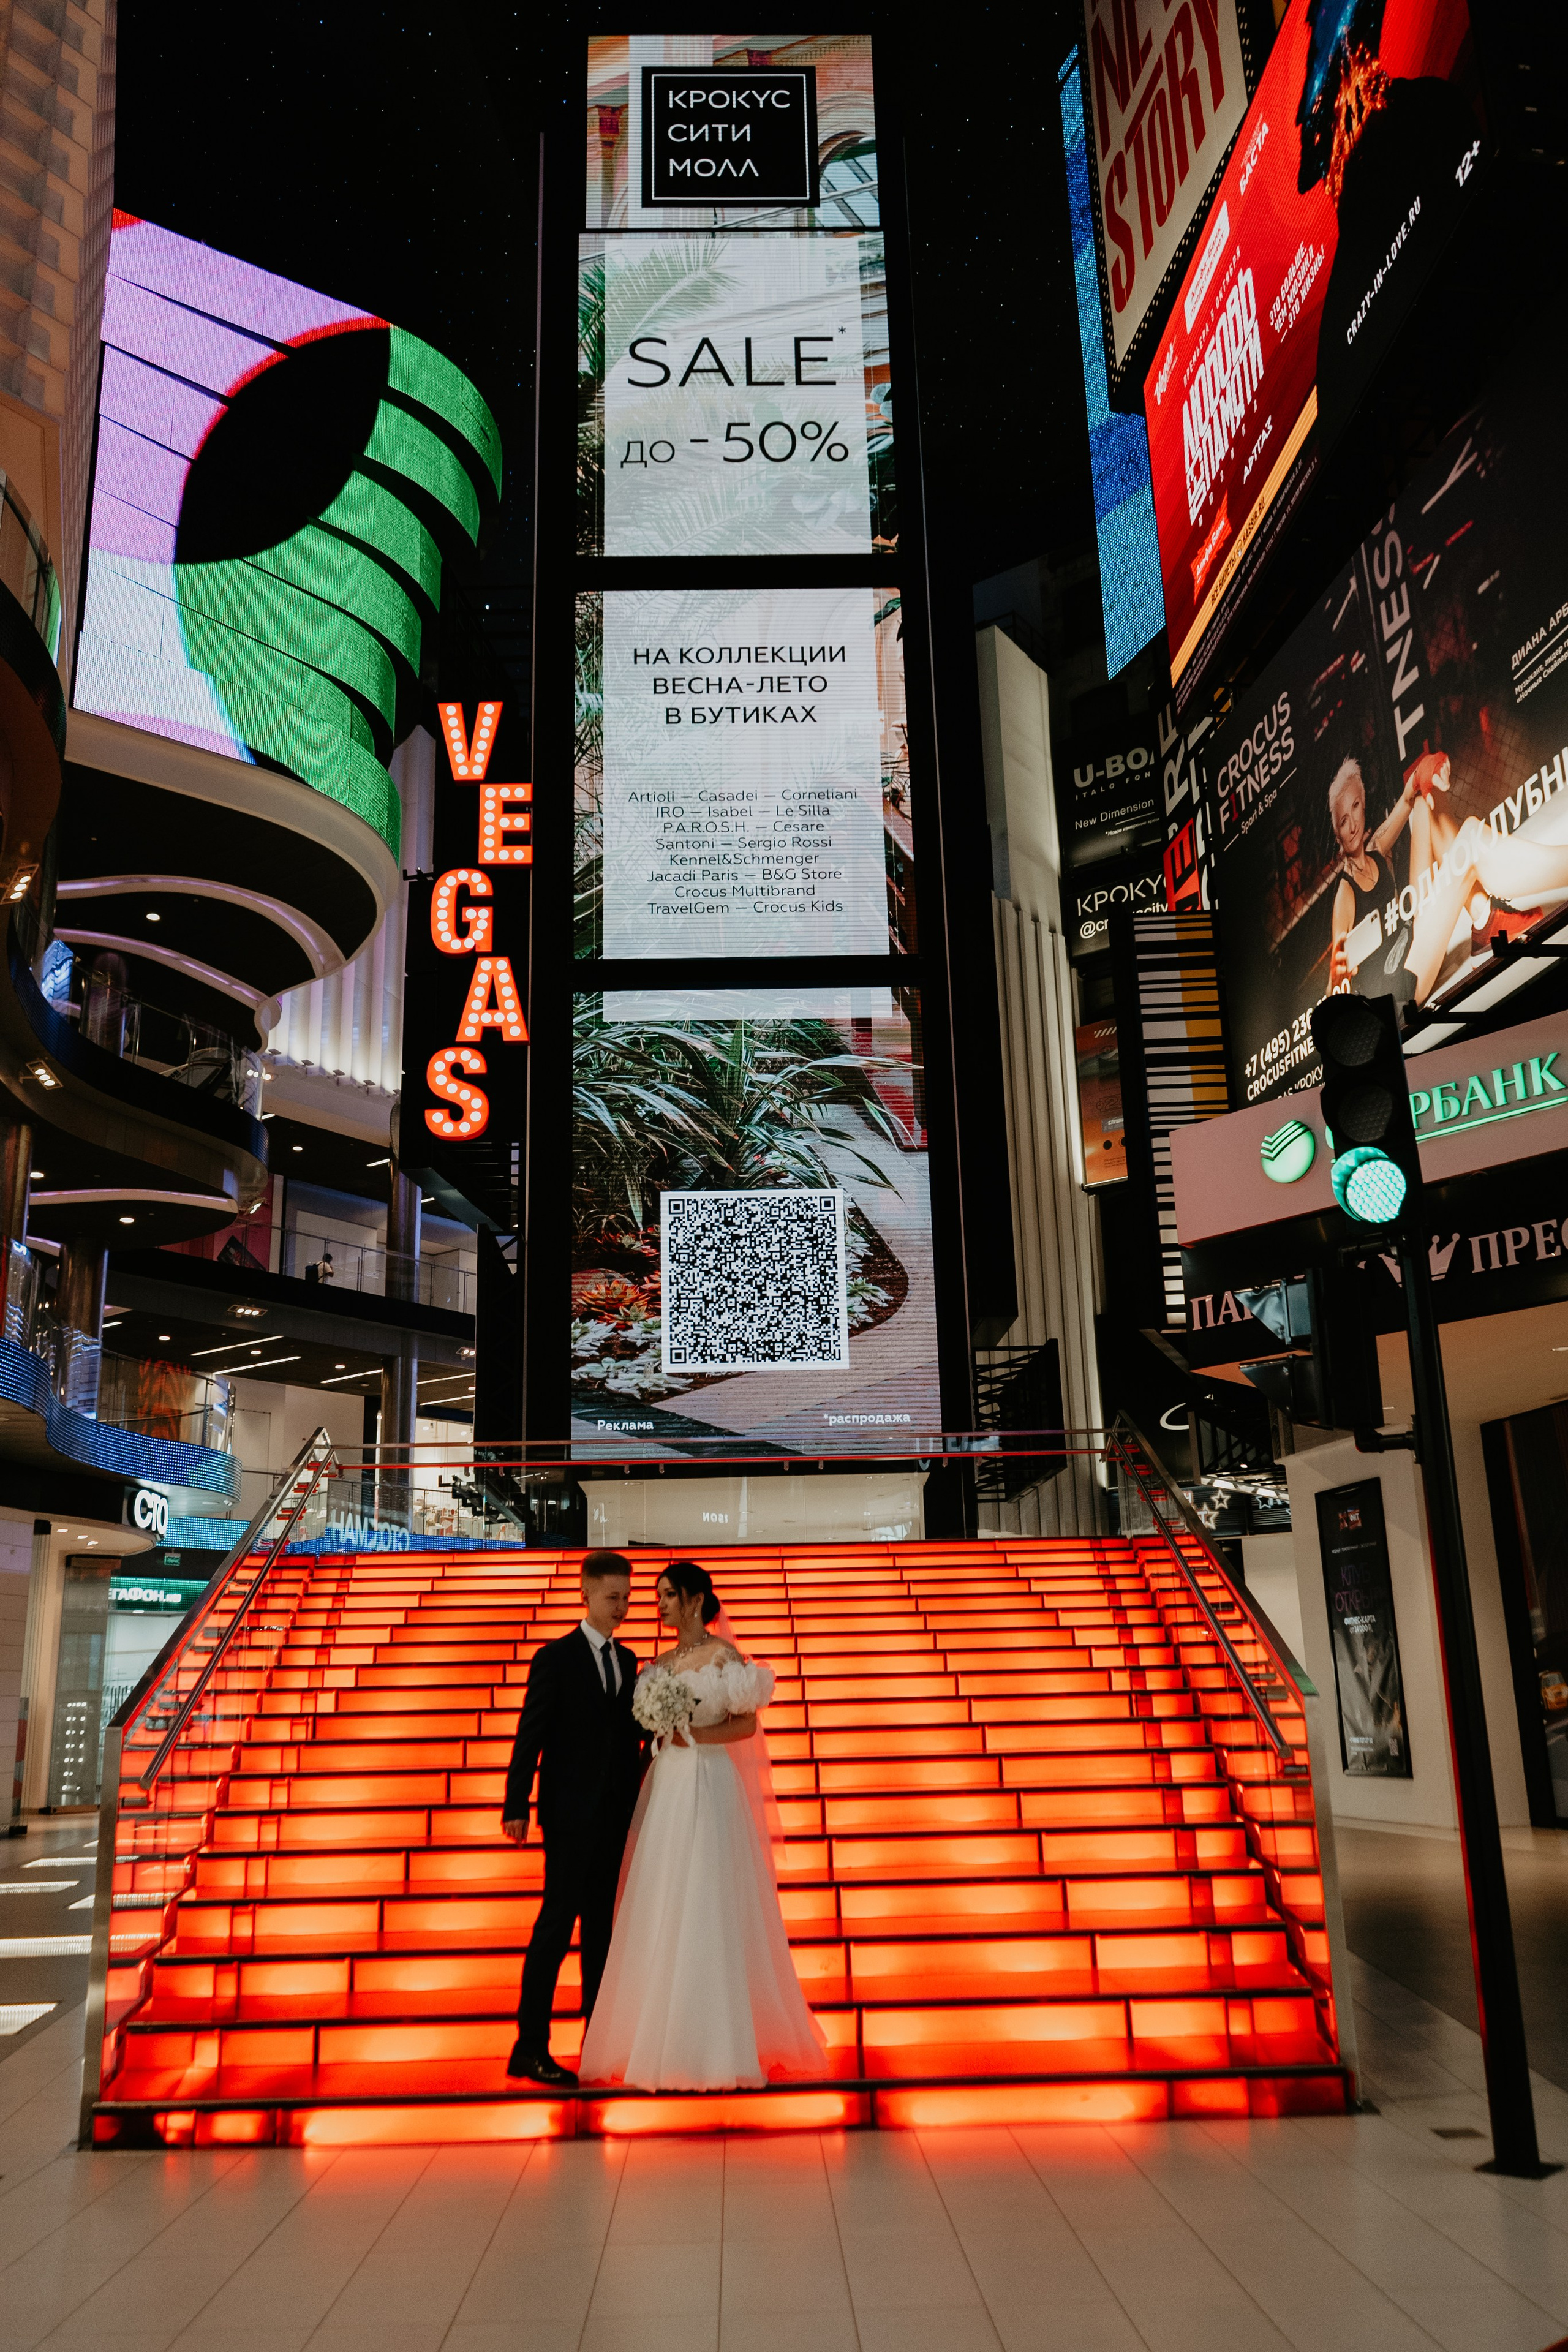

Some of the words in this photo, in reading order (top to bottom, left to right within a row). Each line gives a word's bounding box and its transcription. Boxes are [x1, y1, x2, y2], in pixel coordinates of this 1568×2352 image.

[669, 90, 790, 109] КРОКУС
[668, 124, 751, 142] СИТИ
[669, 158, 759, 177] МОЛЛ
[1240, 122, 1269, 196] БАСТА
[1347, 195, 1421, 345] CRAZY-IN-LOVE.RU
[1183, 323, 1210, 388] ПРЕМЬЕРА
[1215, 246, 1241, 310] ОКТЯБРЯ
[1183, 267, 1257, 473] ЛЮБОВЬ
[1200, 320, 1264, 491] ПАМЯТИ
[633, 648, 671, 665] НА
[679, 646, 846, 666] КОЛЛЕКЦИИ
[1512, 627, 1547, 671] ДИАНА
[1545, 646, 1563, 667] лидер
[652, 676, 828, 695] ВЕСНА-ЛЕТО
[665, 707, 682, 725] В
[691, 705, 818, 725] БУТИКАХ
[1218, 692, 1291, 797] CROCUS
[628, 791, 675, 803] Artioli
[698, 790, 758, 802] Casadei
[782, 788, 858, 801] Corneliani
[1076, 783, 1115, 800] ITALO
[656, 806, 684, 818] IRO
[707, 805, 753, 818] Isabel
[776, 805, 794, 817] Le
[798, 804, 831, 817] Silla
[1074, 816, 1097, 831] New
[1101, 798, 1155, 822] Dimension
[1241, 810, 1257, 834] Sport
[1264, 789, 1277, 808] Spa
[773, 821, 824, 832] Cesare
[655, 837, 715, 850] Santoni
[737, 837, 787, 851] Sergio
[791, 835, 832, 848] Rossi
[669, 853, 820, 867] Kennel&Schmenger
[647, 870, 696, 883] Jacadi
[701, 869, 739, 881] Paris
[762, 868, 796, 881] B&G
[801, 868, 842, 880] Store
[674, 886, 728, 898] Crocus
[732, 884, 815, 897] Multibrand
[1077, 874, 1166, 916] КРОКУ
[647, 902, 730, 915] TravelGem
[753, 901, 805, 913] Crocus
[811, 900, 843, 913] Kids
[424, 701, 533, 1142] VEGAS
[1245, 1054, 1257, 1078] +7
[1260, 1028, 1291, 1071] (495)
[1247, 1035, 1316, 1101] CROCUSFITNE
[597, 1420, 654, 1431] Реклама
